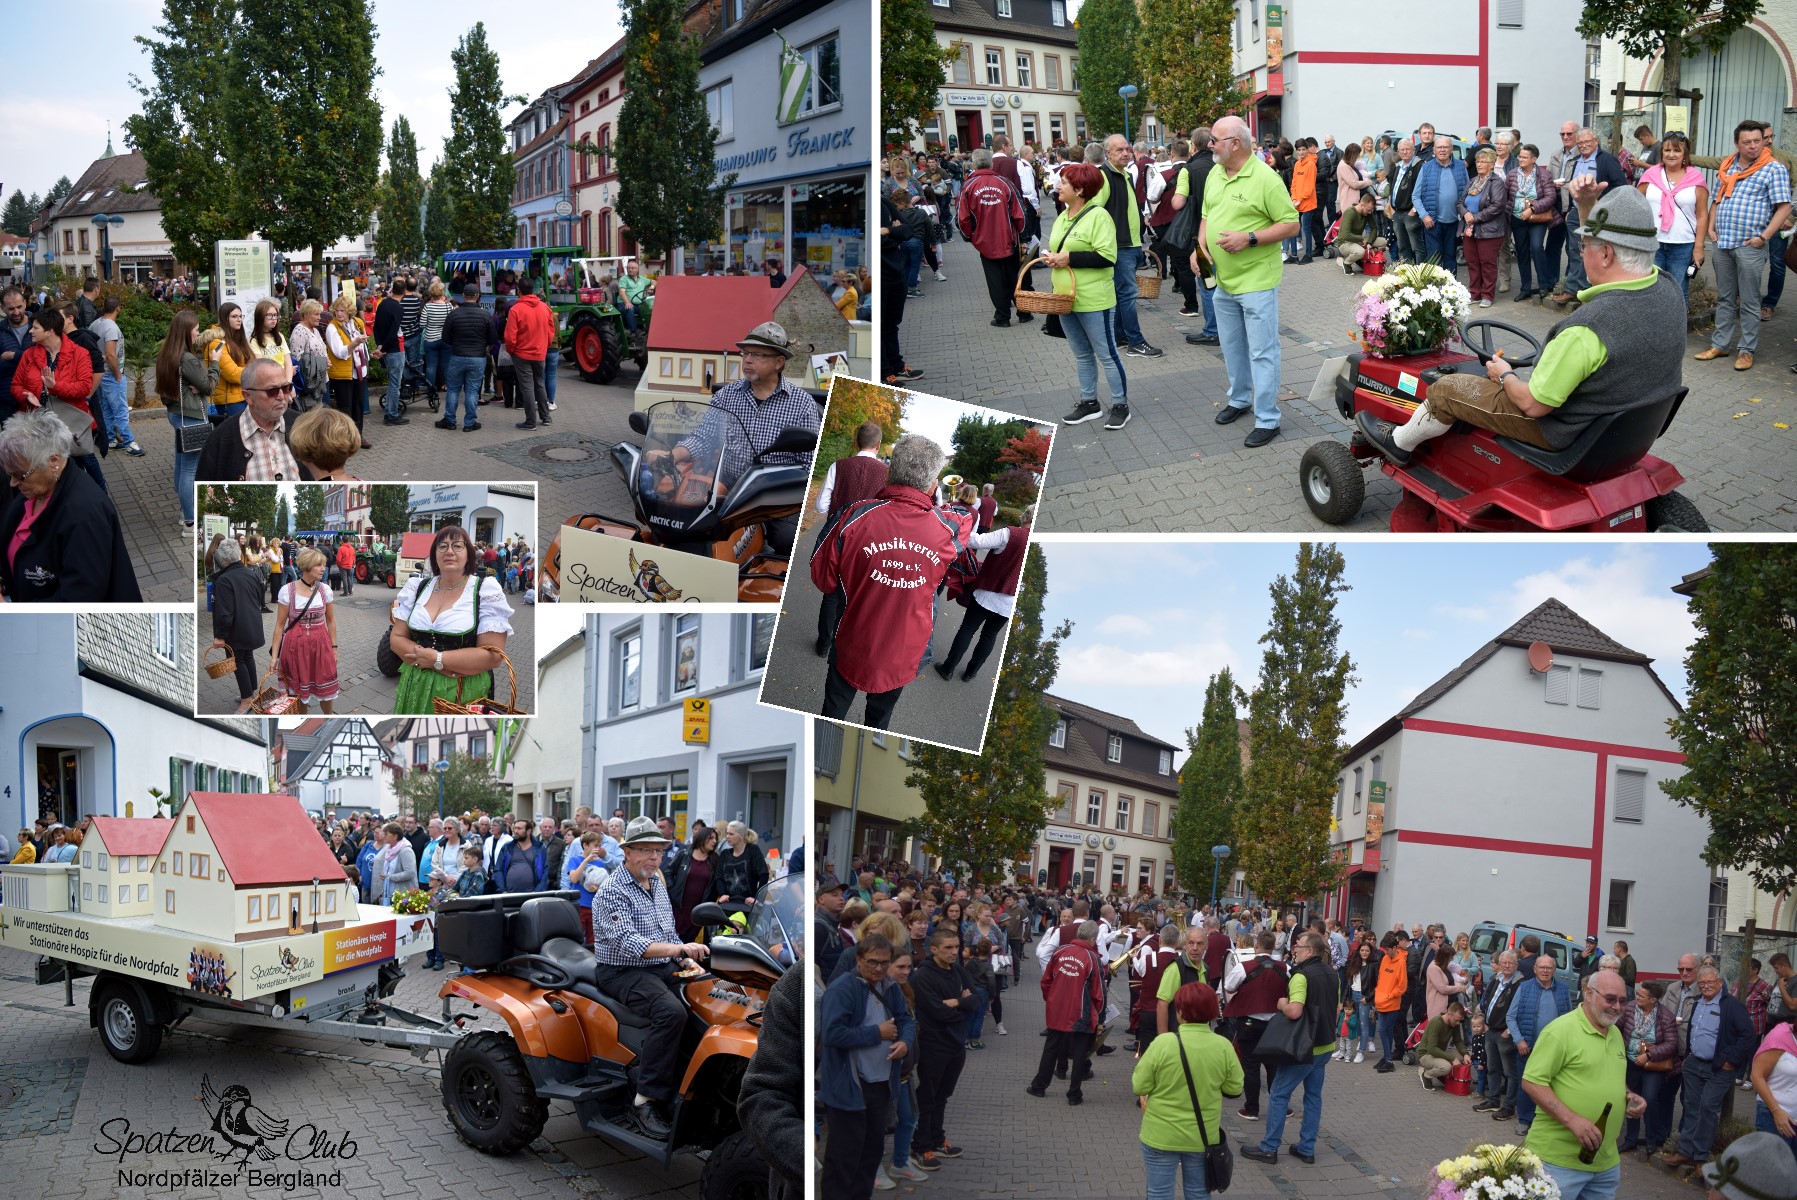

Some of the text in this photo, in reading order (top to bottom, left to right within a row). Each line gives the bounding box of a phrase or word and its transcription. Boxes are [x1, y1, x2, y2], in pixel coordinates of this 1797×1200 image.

[786, 126, 855, 158] FRANCK
[1357, 374, 1395, 396] MURRAY
[649, 515, 684, 530] ARCTIC CAT
[862, 536, 941, 567] Musikverein
[881, 559, 904, 570] 1899
[566, 563, 636, 599] Spatzen
[869, 568, 927, 589] Dörnbach
[4, 785, 11, 798] 4
[13, 915, 89, 941] Wir unterstützen das
[336, 931, 388, 950] Stationäres Hospiz
[29, 935, 179, 977] Stationäre Hospiz für die Nordpfalz
[335, 946, 383, 964] für die Nordpfalz
[250, 957, 315, 982] Spatzen Club
[256, 971, 311, 990] Nordpfälzer Bergland
[708, 987, 752, 1007] ARCTIC
